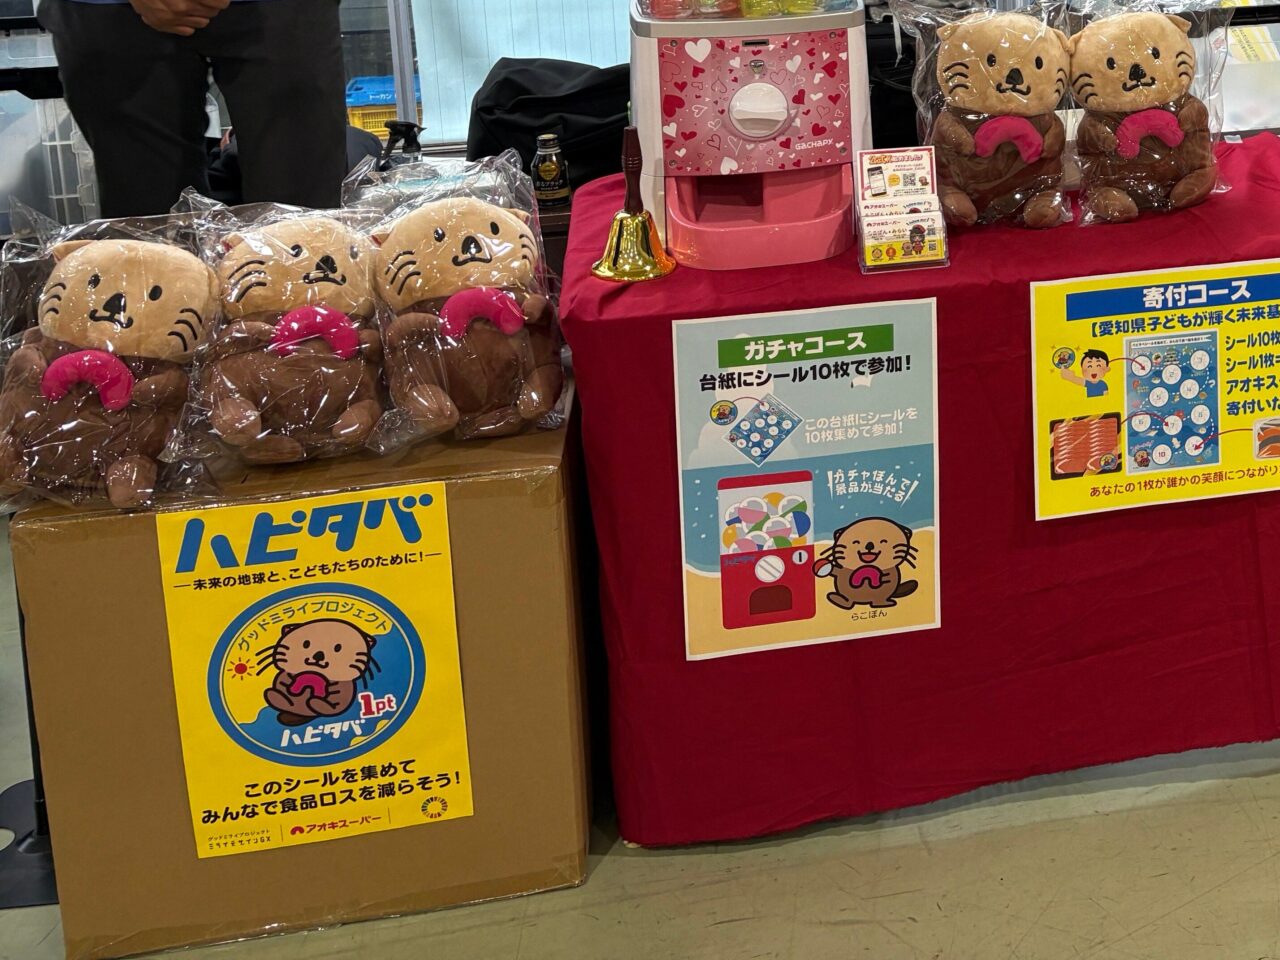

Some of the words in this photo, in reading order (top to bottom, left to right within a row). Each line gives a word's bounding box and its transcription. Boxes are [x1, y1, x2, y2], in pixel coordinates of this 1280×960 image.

[1143, 280, 1251, 309] 寄付コース
[745, 332, 867, 361] ガチャコース
[699, 355, 911, 392] 台紙にシール10枚で参加!
[804, 407, 918, 430] この台紙にシールを
[804, 422, 904, 444] 10枚集めて参加!
[237, 600, 388, 651] グッドミライプロジェクト
[361, 693, 396, 716] 1pt
[245, 759, 416, 798] このシールを集めて
[201, 771, 461, 824] みんなで食品ロスを減らそう!
[306, 816, 382, 834] アオキスーパー
